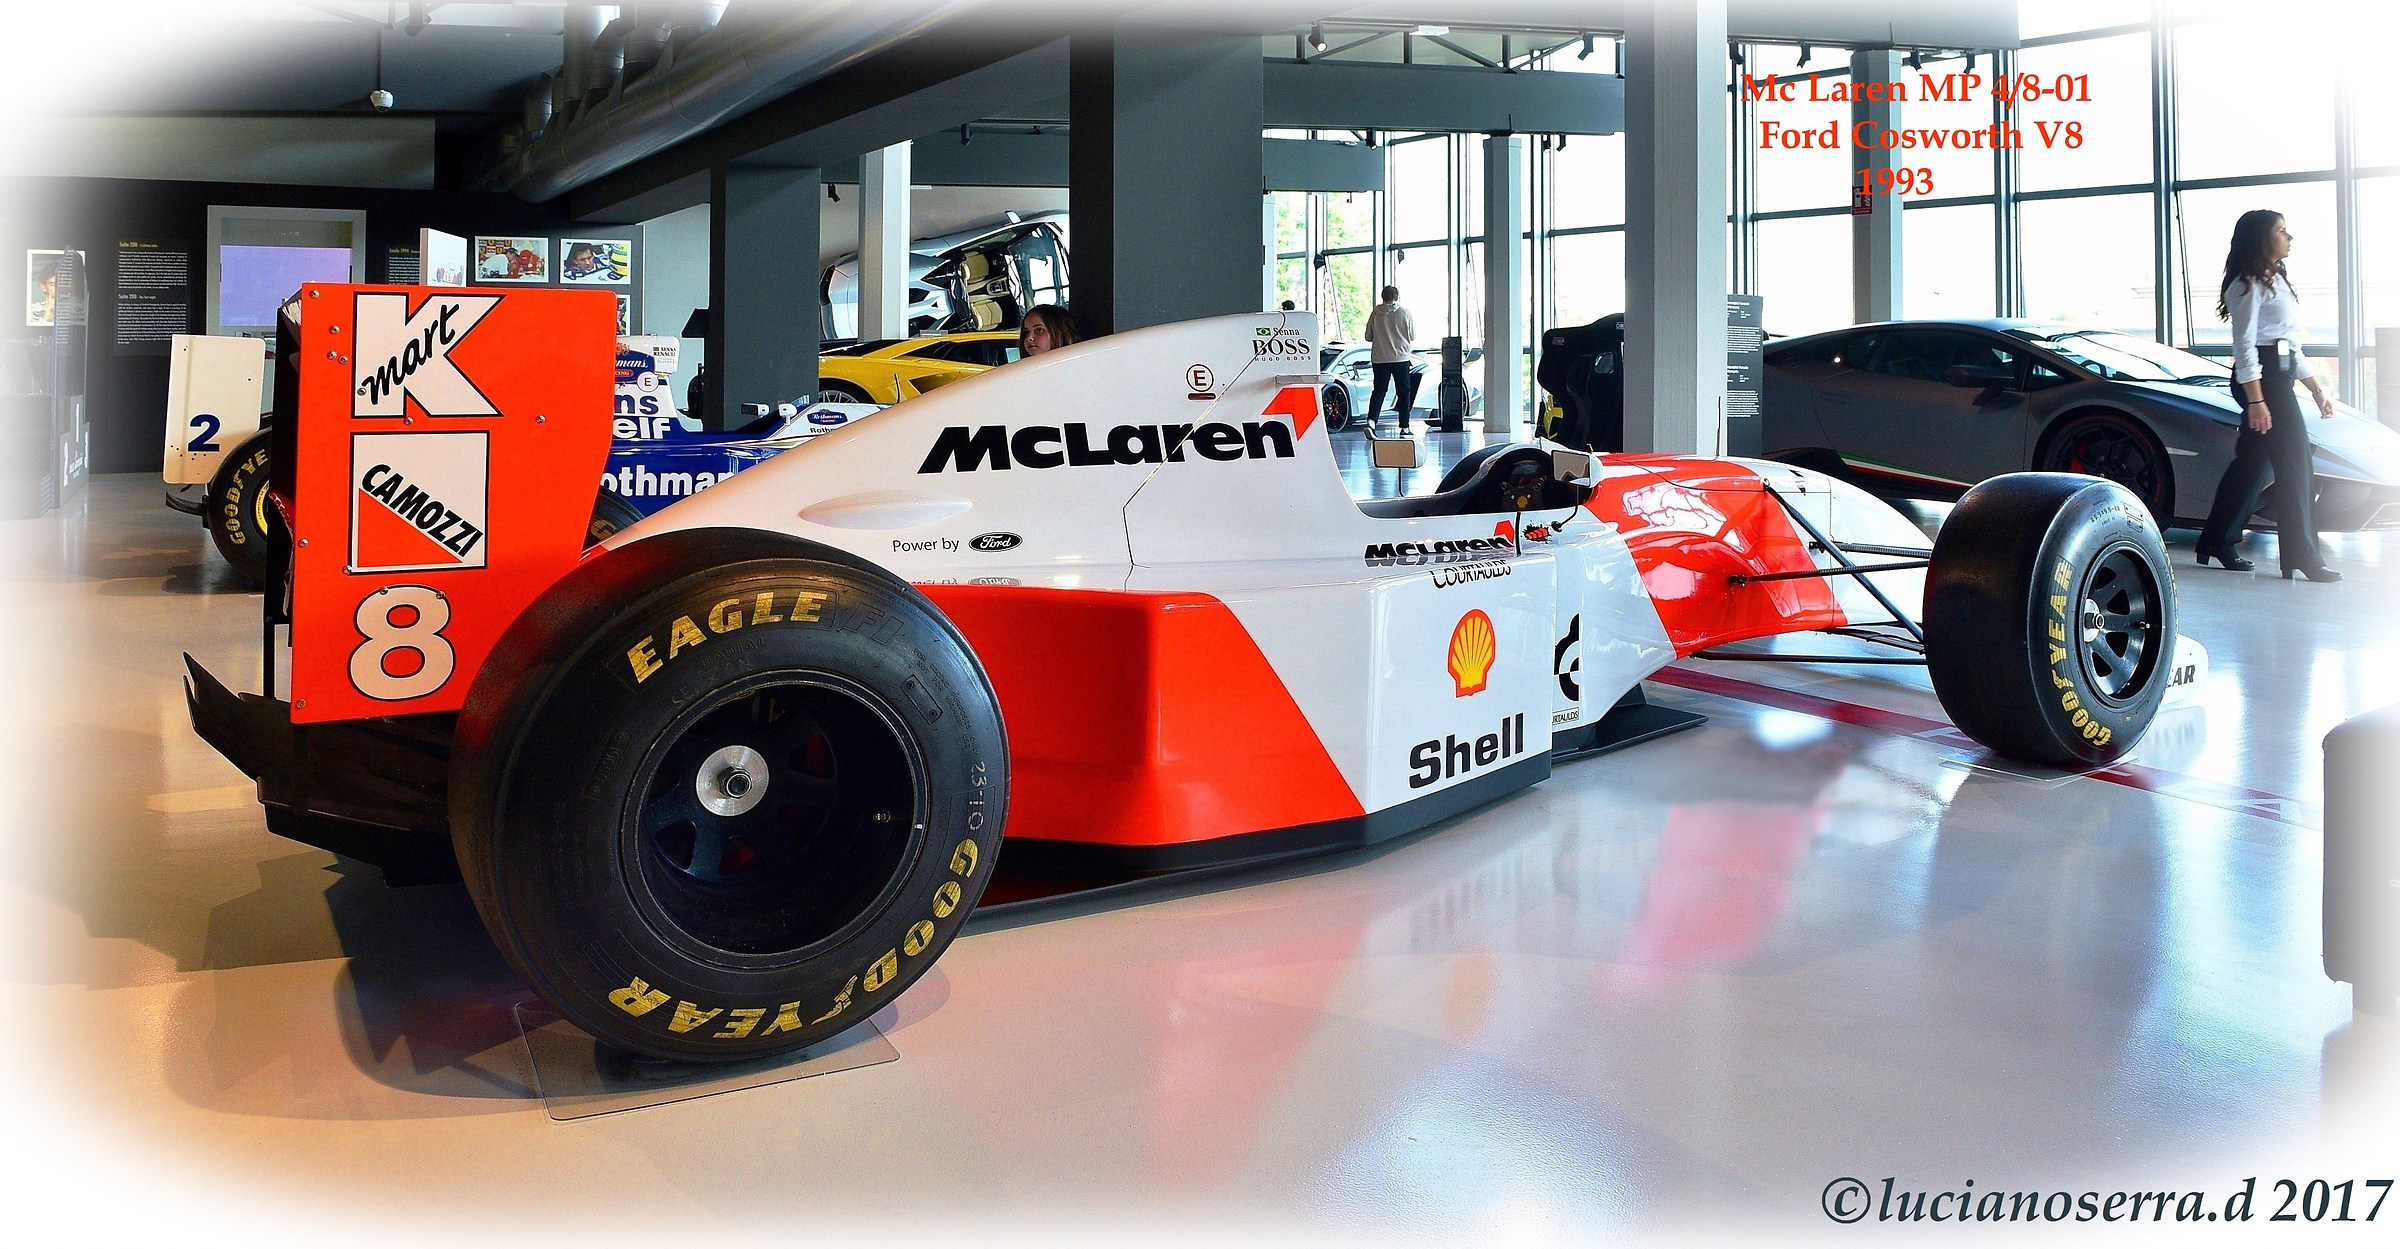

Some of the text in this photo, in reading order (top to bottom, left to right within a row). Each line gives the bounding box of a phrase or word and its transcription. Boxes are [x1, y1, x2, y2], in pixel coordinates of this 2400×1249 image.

[1252, 338, 1311, 355] BOSS
[1273, 327, 1300, 336] Senna
[352, 292, 507, 419] K
[361, 304, 459, 405] mart
[644, 377, 652, 387] E
[1193, 369, 1207, 387] E
[187, 414, 221, 453] 2
[613, 417, 671, 440] elf
[916, 420, 1296, 475] McLaren
[361, 463, 484, 558] CAMOZZI
[892, 537, 960, 553] Power by
[980, 534, 1012, 549] Ford
[1364, 535, 1516, 558] McLaren
[1430, 560, 1512, 589] COURTAULDS
[346, 583, 457, 703] 8
[625, 592, 828, 684] EAGLE
[2048, 561, 2113, 746] GOODYEAR
[1409, 712, 1524, 789] Shell
[608, 838, 980, 1040] GOODYEAR
